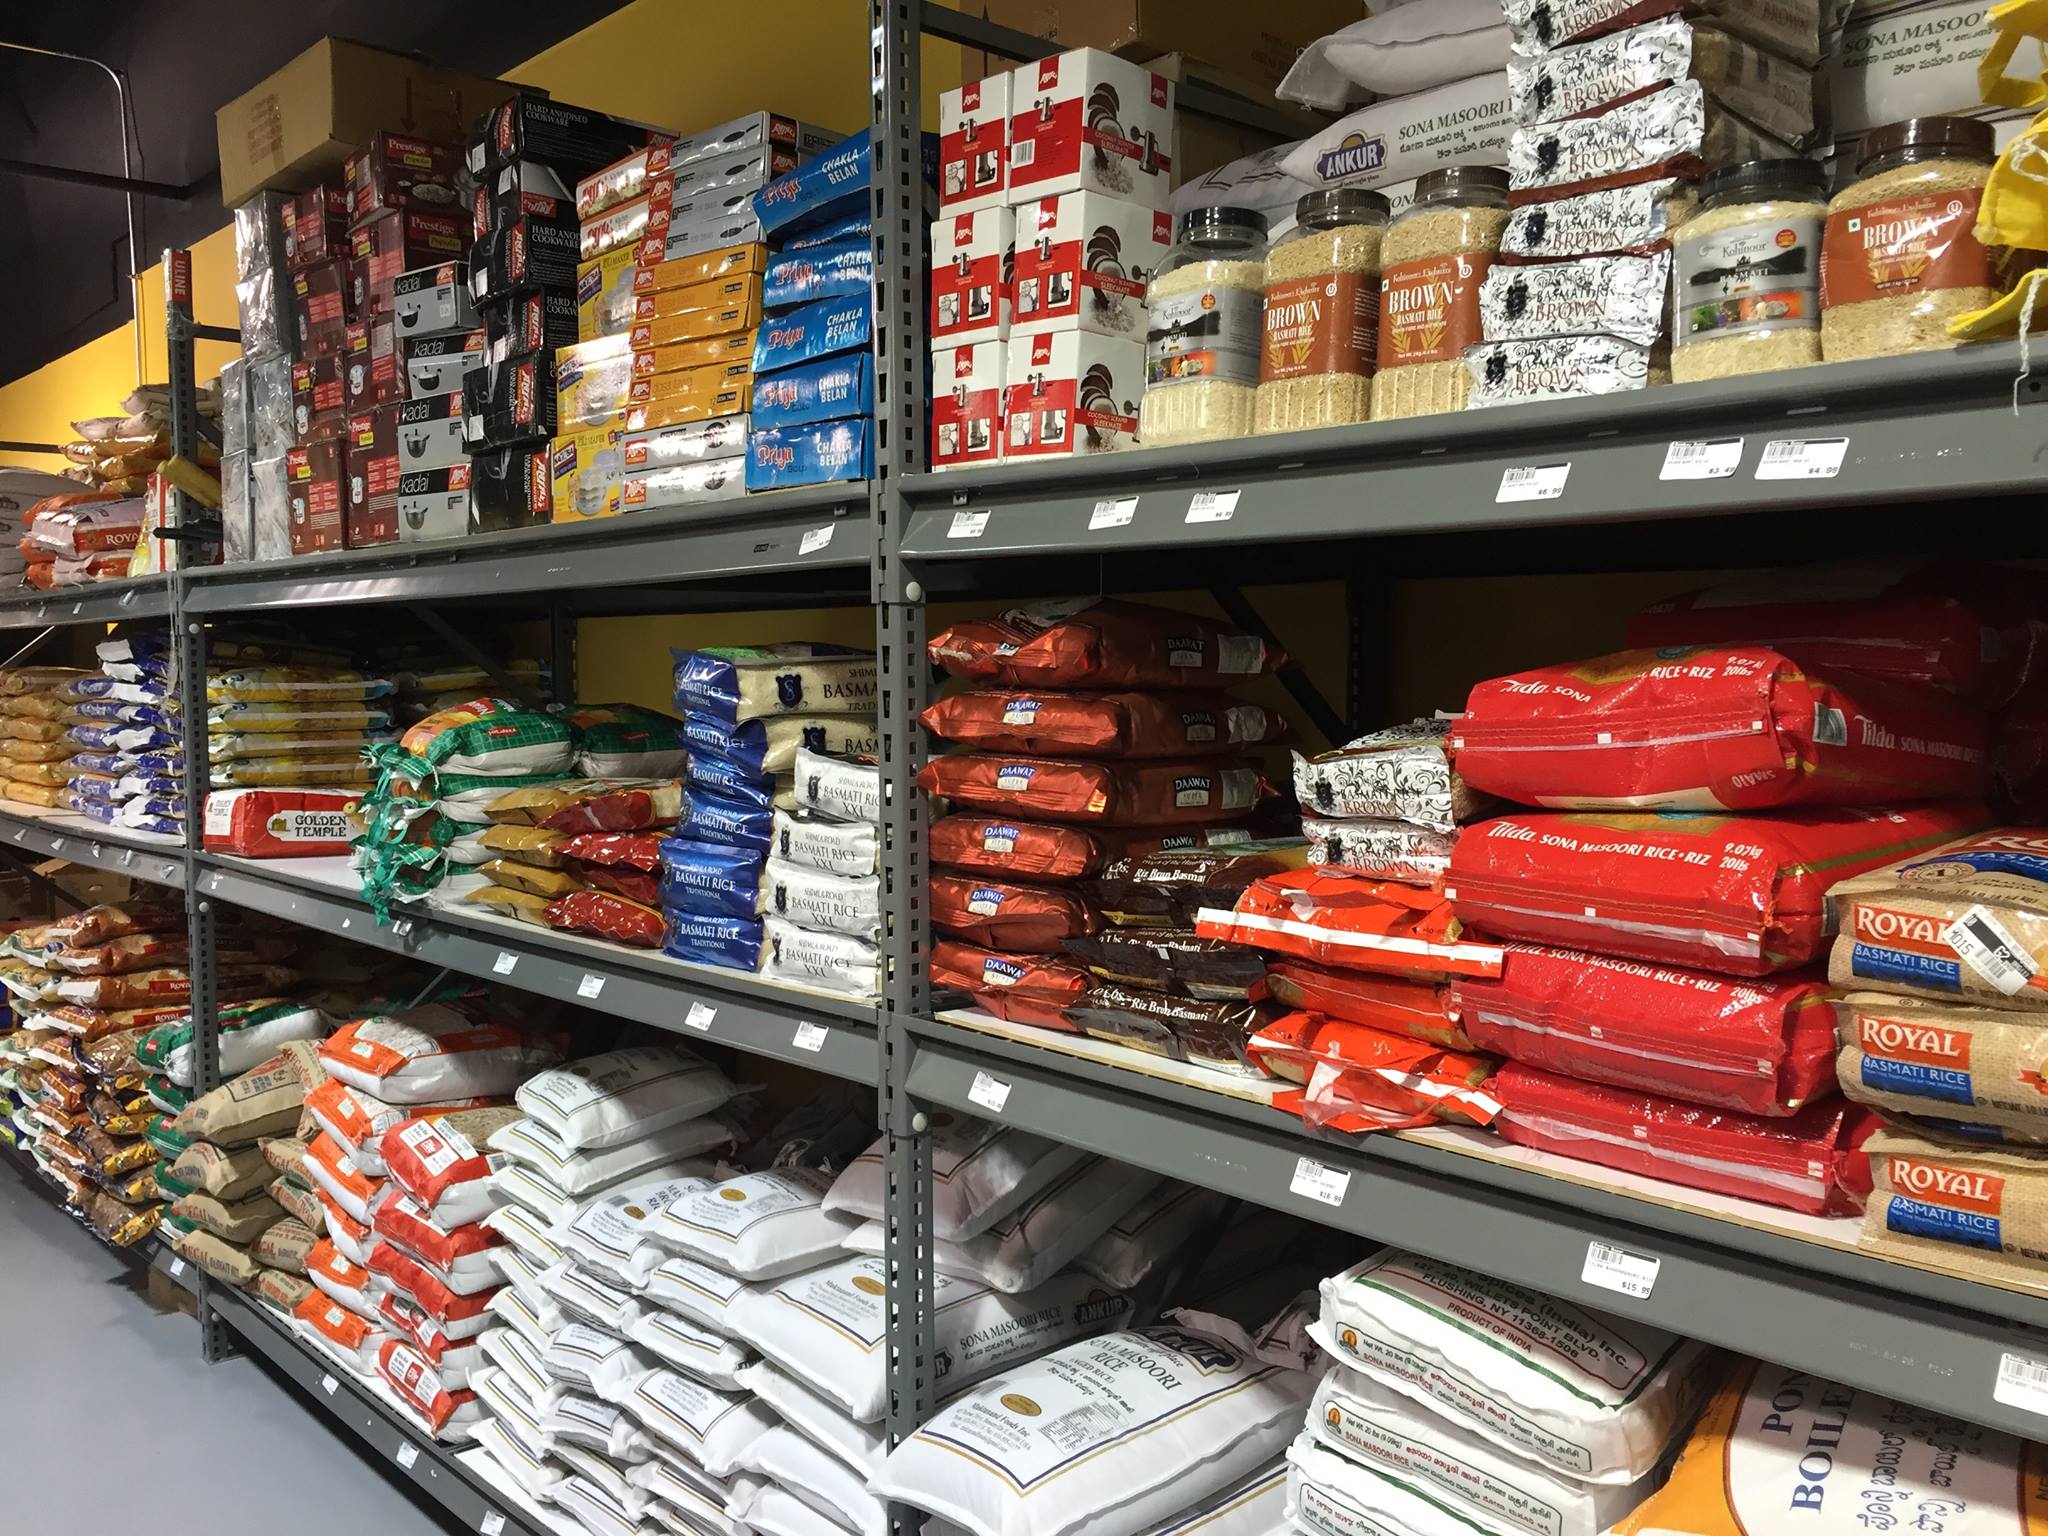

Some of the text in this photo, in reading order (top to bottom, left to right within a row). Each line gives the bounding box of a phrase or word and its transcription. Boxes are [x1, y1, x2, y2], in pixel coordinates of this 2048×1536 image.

[1562, 0, 1626, 37] BROWN
[1902, 11, 1987, 42] MASOO
[1562, 70, 1638, 112] BROWN
[526, 102, 589, 124] HARD ANODISED
[526, 111, 569, 127] COOKWARE
[1398, 118, 1434, 141] SONA
[1437, 99, 1504, 130] MASOORI
[389, 138, 427, 154] Prestige
[821, 148, 860, 173] CHAKLA
[1325, 144, 1378, 179] ANKUR
[1568, 147, 1645, 174] BROWN
[827, 162, 860, 185] BELAN
[411, 214, 456, 235] Prestige
[531, 224, 556, 239] HARD
[1554, 216, 1615, 233] BASMATI
[1863, 217, 1938, 250] BROWN
[531, 233, 580, 249] COOKWARE
[1552, 228, 1625, 251] BROWN
[1722, 243, 1768, 259] Kohinoor
[174, 259, 187, 296] ULINE
[396, 274, 422, 295] kadai
[547, 296, 570, 308] HARD
[1388, 281, 1454, 314] BROWN
[826, 306, 863, 328] CHAKLA
[1267, 299, 1322, 330] BROWN
[1397, 308, 1443, 326] BASMATI RICE
[1535, 300, 1607, 323] BROWN
[767, 325, 804, 350] Priya
[826, 322, 858, 338] BELAN
[1273, 323, 1313, 341] BASMATI RICE
[413, 339, 446, 357] kadai
[820, 388, 848, 403] BELAN
[402, 400, 430, 423] kadai
[758, 444, 794, 472] Priya
[400, 473, 430, 494] kadai
[823, 683, 878, 700] BASMA
[1552, 666, 1716, 703] SONA RICE RIZ
[1005, 700, 1043, 713] DAAWAT
[687, 727, 721, 745] BASMATI
[1855, 715, 1897, 750] Tilda
[999, 765, 1037, 778] DAAWAT
[823, 785, 862, 802] BASMATI
[1174, 778, 1211, 790] DAAWAT
[1340, 789, 1394, 801] BASMATI
[843, 803, 865, 818] XXL
[1343, 800, 1407, 816] BROWN
[295, 814, 347, 826] GOLDEN
[691, 812, 749, 836] BASMATI RICE
[295, 826, 347, 838] TEMPLE
[984, 826, 1020, 840] DAAWAT
[794, 841, 857, 861] BASMATI RICE
[1487, 820, 1711, 867] Tilda SONA MASOORI RICE RIZ
[1724, 842, 1764, 860] 9.07kg
[813, 859, 836, 872] XXL
[1134, 868, 1172, 880] Riz Brun
[1352, 857, 1418, 874] BROWN
[1719, 855, 1750, 872] 20lbs
[675, 871, 736, 892] BASMATI RICE
[685, 886, 721, 901] TRADITIONAL
[972, 889, 1005, 902] DAAWAT
[791, 896, 859, 917] BASMATI RICE
[811, 913, 834, 928] XXL
[681, 924, 740, 940] BASMATI RICE
[691, 938, 726, 950] TRADITIONAL
[785, 947, 853, 968] BASMATI RICE
[1855, 944, 1917, 968] BASMATI
[1920, 957, 1956, 976] RICE
[1548, 947, 1720, 993] SONA MASOORI RICE RIZ
[1730, 985, 1764, 1003] 20lbs
[1131, 998, 1209, 1022] Riz Basmati
[1863, 1017, 1961, 1057] ROYAL
[1863, 1054, 1926, 1079] BASMATI
[1930, 1068, 1967, 1086] RICE
[263, 1146, 290, 1176] REGAL
[1892, 1157, 1993, 1203] ROYAL
[1892, 1197, 1996, 1232] BASMATI RICE
[181, 1243, 209, 1264] REGAL
[1079, 1297, 1124, 1325] ANKUR
[1422, 1272, 1580, 1359] FLUSHING, NY 11368-1506
[960, 1305, 1064, 1351] SONA MASOORI RICE
[1447, 1302, 1533, 1354] PRODUCT OF INDIA
[1521, 1306, 1560, 1335] POINT
[1563, 1331, 1602, 1363] BLVD.
[1090, 1351, 1129, 1374] RICE
[1363, 1352, 1385, 1367] SONA
[1599, 1338, 1631, 1371] Inc.
[1114, 1341, 1184, 1393] MASOORI
[1364, 1424, 1372, 1434] 20
[1345, 1430, 1410, 1468] SONA MASOORI RICE
[1790, 1385, 1856, 1515] BOILE
